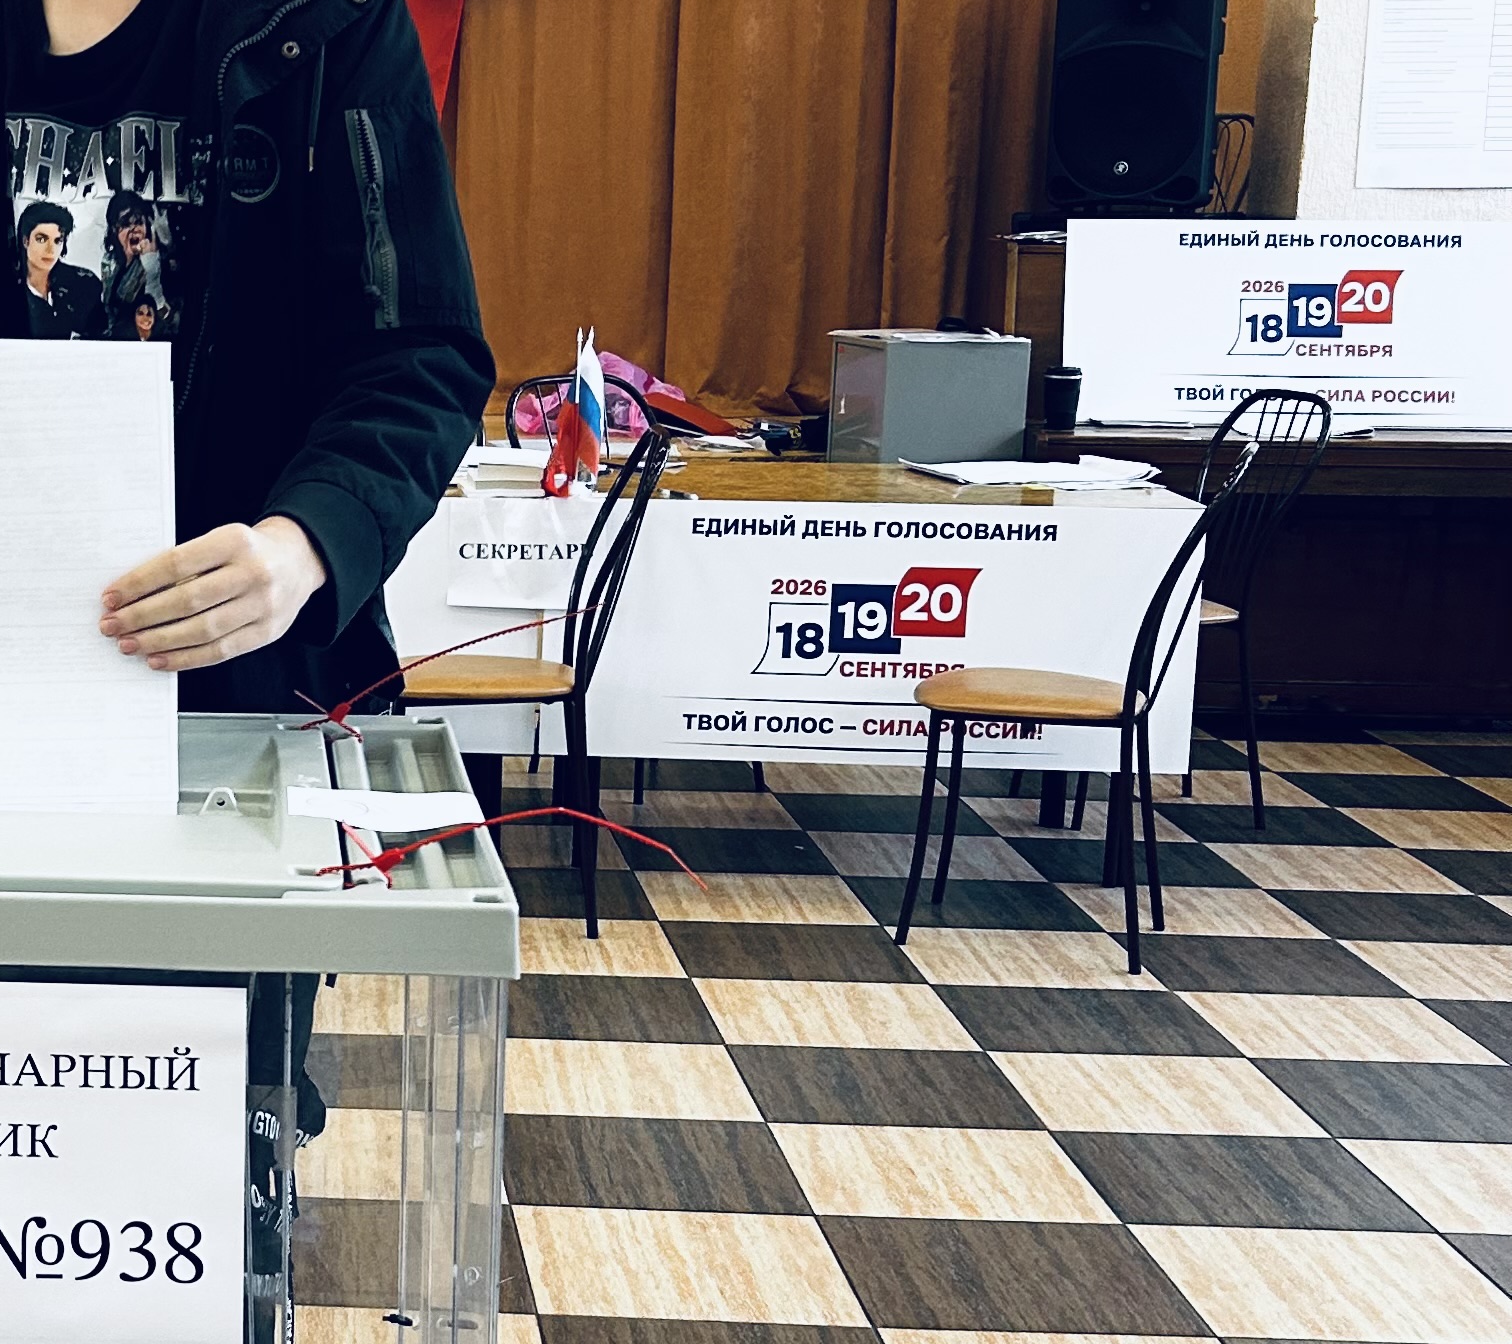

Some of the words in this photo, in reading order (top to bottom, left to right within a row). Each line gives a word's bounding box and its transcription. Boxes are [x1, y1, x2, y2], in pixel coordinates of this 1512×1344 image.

[5, 117, 189, 203] HAEL
[1179, 230, 1260, 248] ЕДИНЫЙ
[1265, 234, 1315, 249] ДЕНЬ
[1320, 234, 1462, 249] ГОЛОСОВАНИЯ
[1241, 280, 1285, 293] 2026
[1245, 314, 1283, 343] 18
[1292, 296, 1332, 327] 19
[1341, 281, 1390, 313] 20
[1295, 344, 1393, 357] СЕНТЯБРЯ
[1174, 385, 1224, 401] ТВОЙ
[1372, 390, 1455, 404] РОССИИ!
[692, 514, 796, 538] ЕДИНЫЙ
[802, 520, 866, 540] ДЕНЬ
[874, 521, 1058, 542] ГОЛОСОВАНИЯ
[770, 578, 827, 596] 2026
[775, 622, 824, 659] 18
[837, 601, 888, 640] 19
[900, 583, 962, 622] 20
[683, 711, 747, 732] ТВОЙ
[754, 715, 834, 735] ГОЛОС
[862, 718, 928, 737] СИЛА
